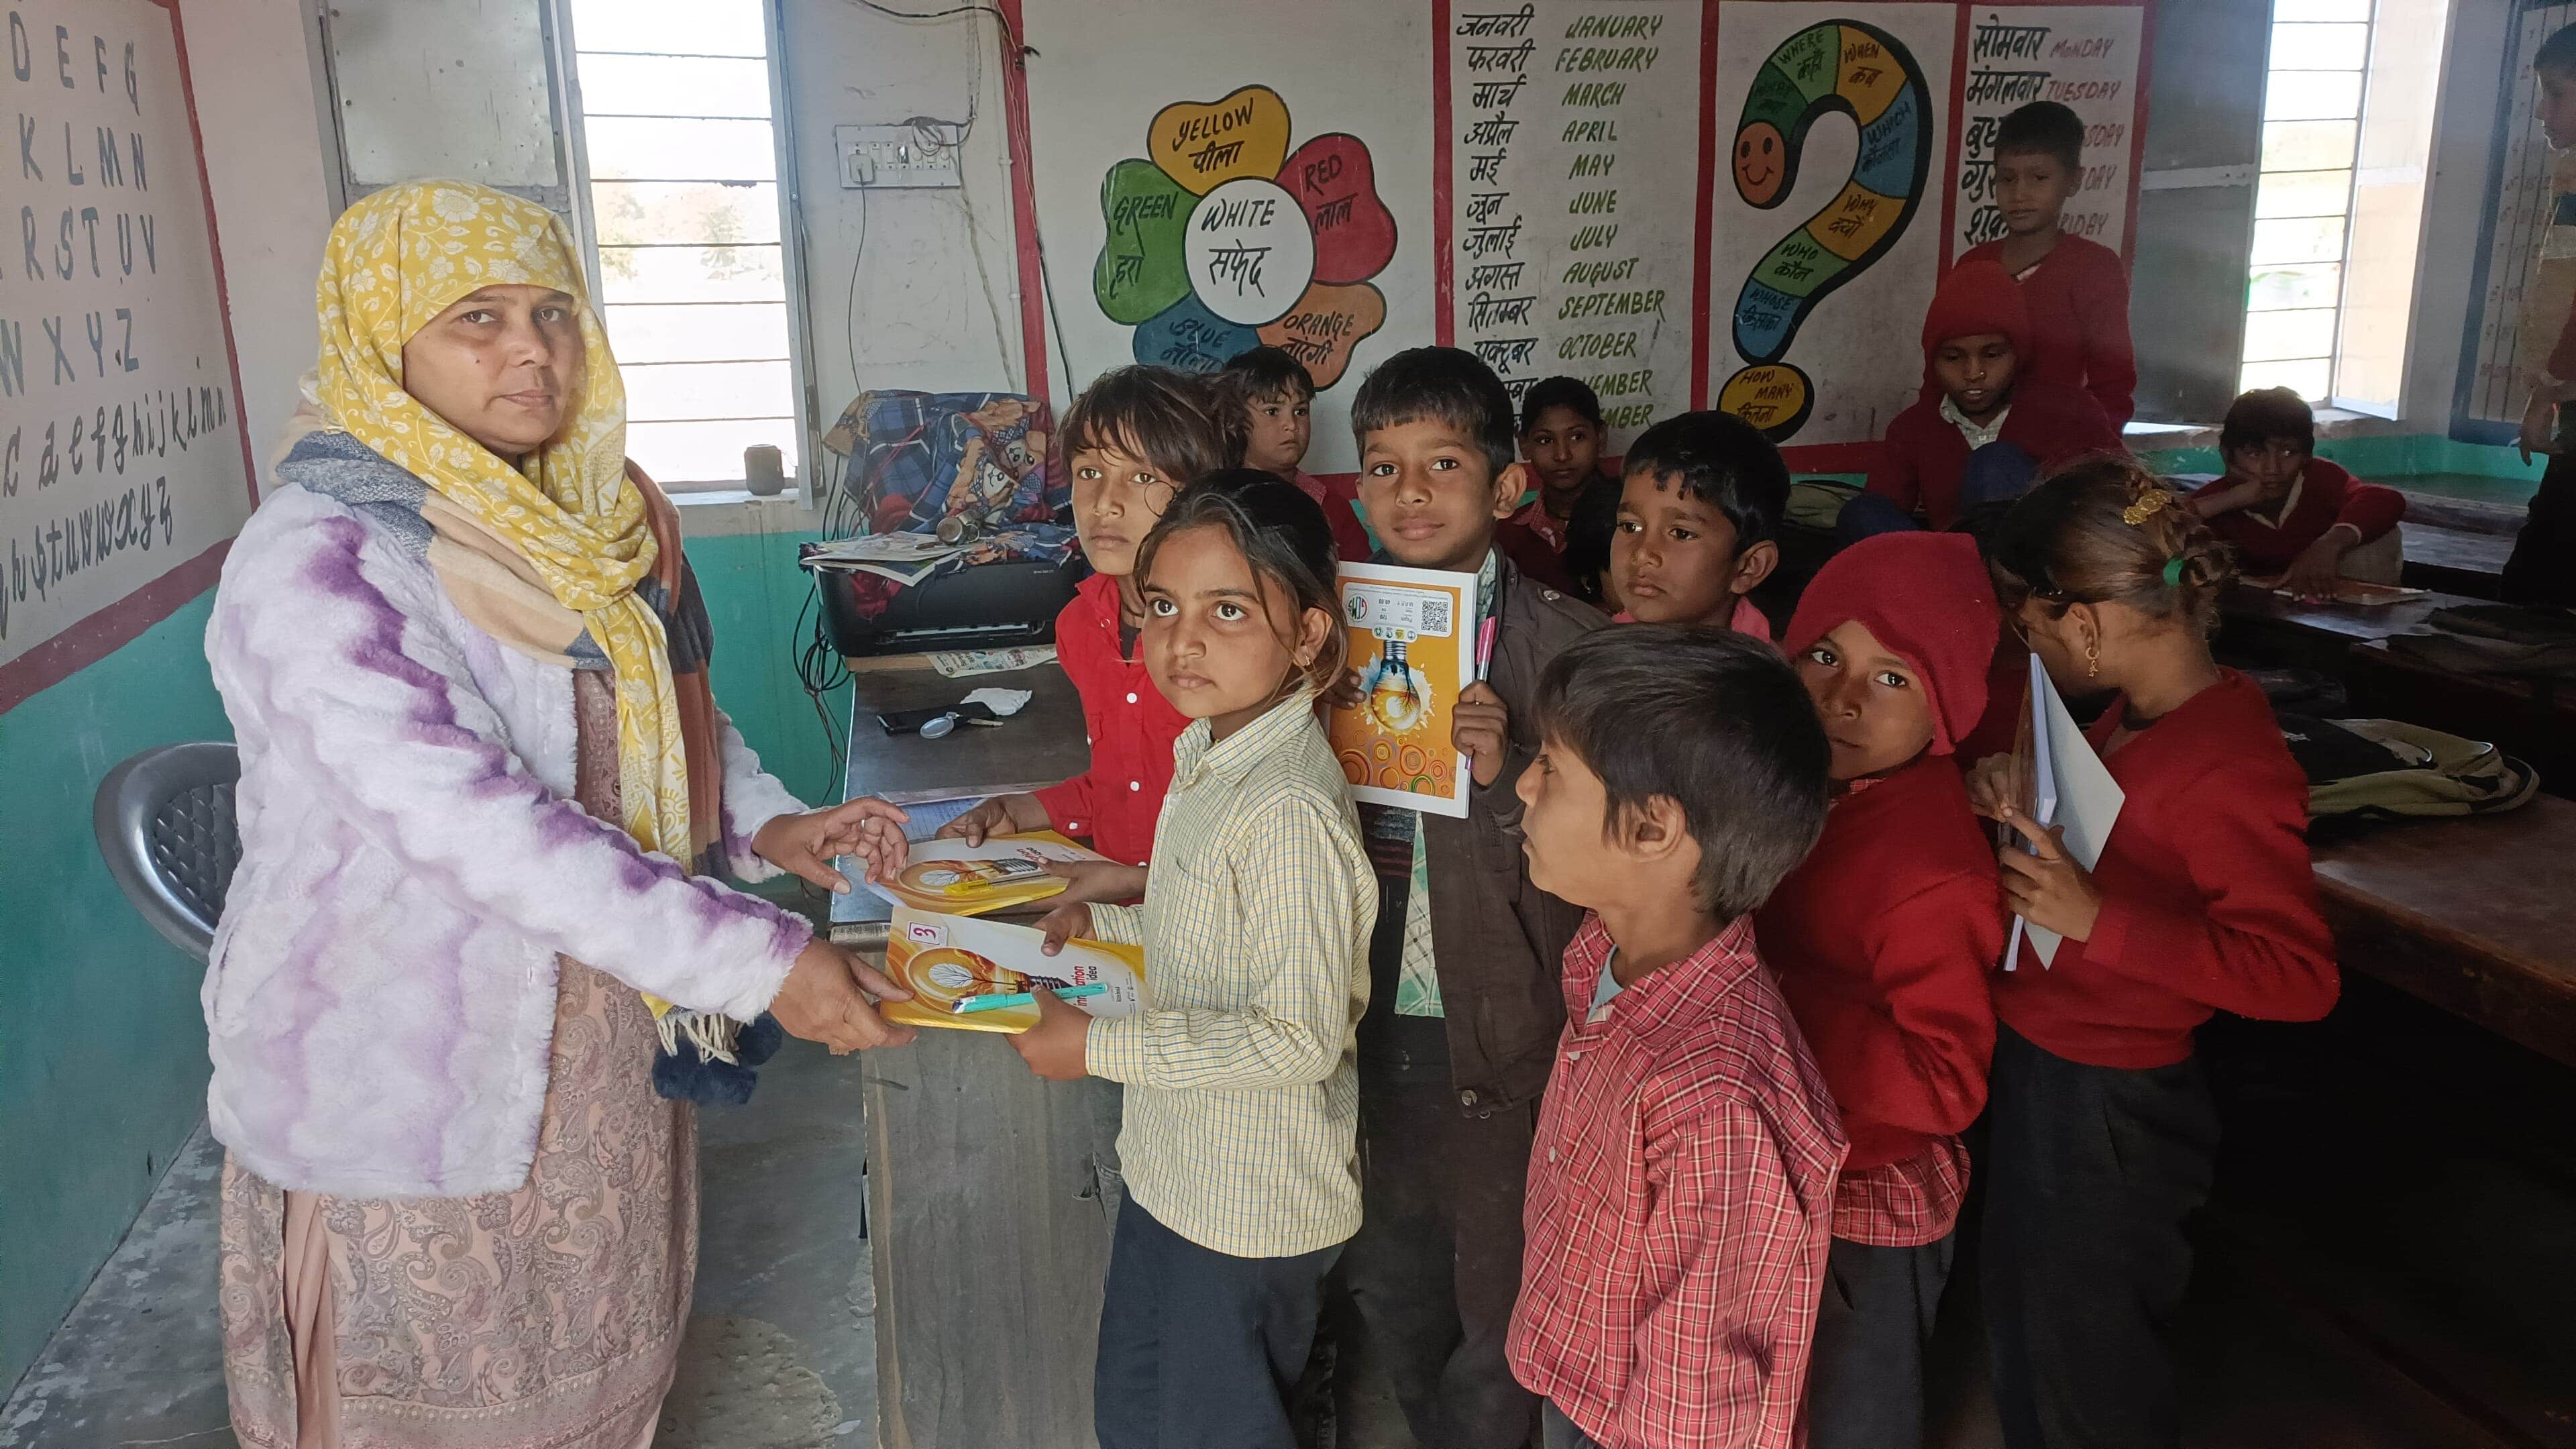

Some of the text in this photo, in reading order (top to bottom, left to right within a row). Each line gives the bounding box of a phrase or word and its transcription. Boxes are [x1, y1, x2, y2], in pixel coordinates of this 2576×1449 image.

[1456, 3, 1535, 38] जनवरी
[1565, 14, 1663, 40] JANUARY
[1779, 30, 1825, 64] WHERE
[1844, 43, 1880, 64] WHEN
[1974, 13, 2051, 63] सोमवार
[1466, 38, 1536, 72] फरवरी
[1555, 46, 1659, 72] FEBRUARY
[1472, 73, 1527, 109] मार्च
[1561, 81, 1627, 109] MARCH
[1967, 64, 2051, 105] मंगलवार
[2046, 80, 2121, 101] TUESDAY
[1172, 97, 1254, 151] YELLOW
[1562, 120, 1617, 143] APRIL
[1189, 140, 1245, 173] पीला
[1470, 147, 1507, 186] मई
[1568, 154, 1615, 180] MAY
[1303, 155, 1342, 195] RED
[1201, 199, 1275, 231] WHITE
[1314, 193, 1358, 235] लाल
[1568, 189, 1617, 215] JUNE
[1842, 195, 1878, 215] WHY
[1113, 192, 1178, 257] GREEN
[1462, 214, 1522, 260] जुलाई
[1570, 223, 1618, 251] JULY
[1780, 242, 1819, 260] WHO
[1110, 255, 1146, 300] हरा
[1209, 239, 1272, 297] सफेद
[1464, 262, 1525, 290] अगस्त
[1562, 257, 1640, 288] AUGUST
[1558, 289, 1666, 322] SEPTEMBER
[1169, 318, 1232, 348] BLUE
[1283, 311, 1355, 343] ORANGE
[1558, 332, 1638, 360] OCTOBER
[1739, 369, 1775, 385] HOW
[913, 927, 936, 940] 3
